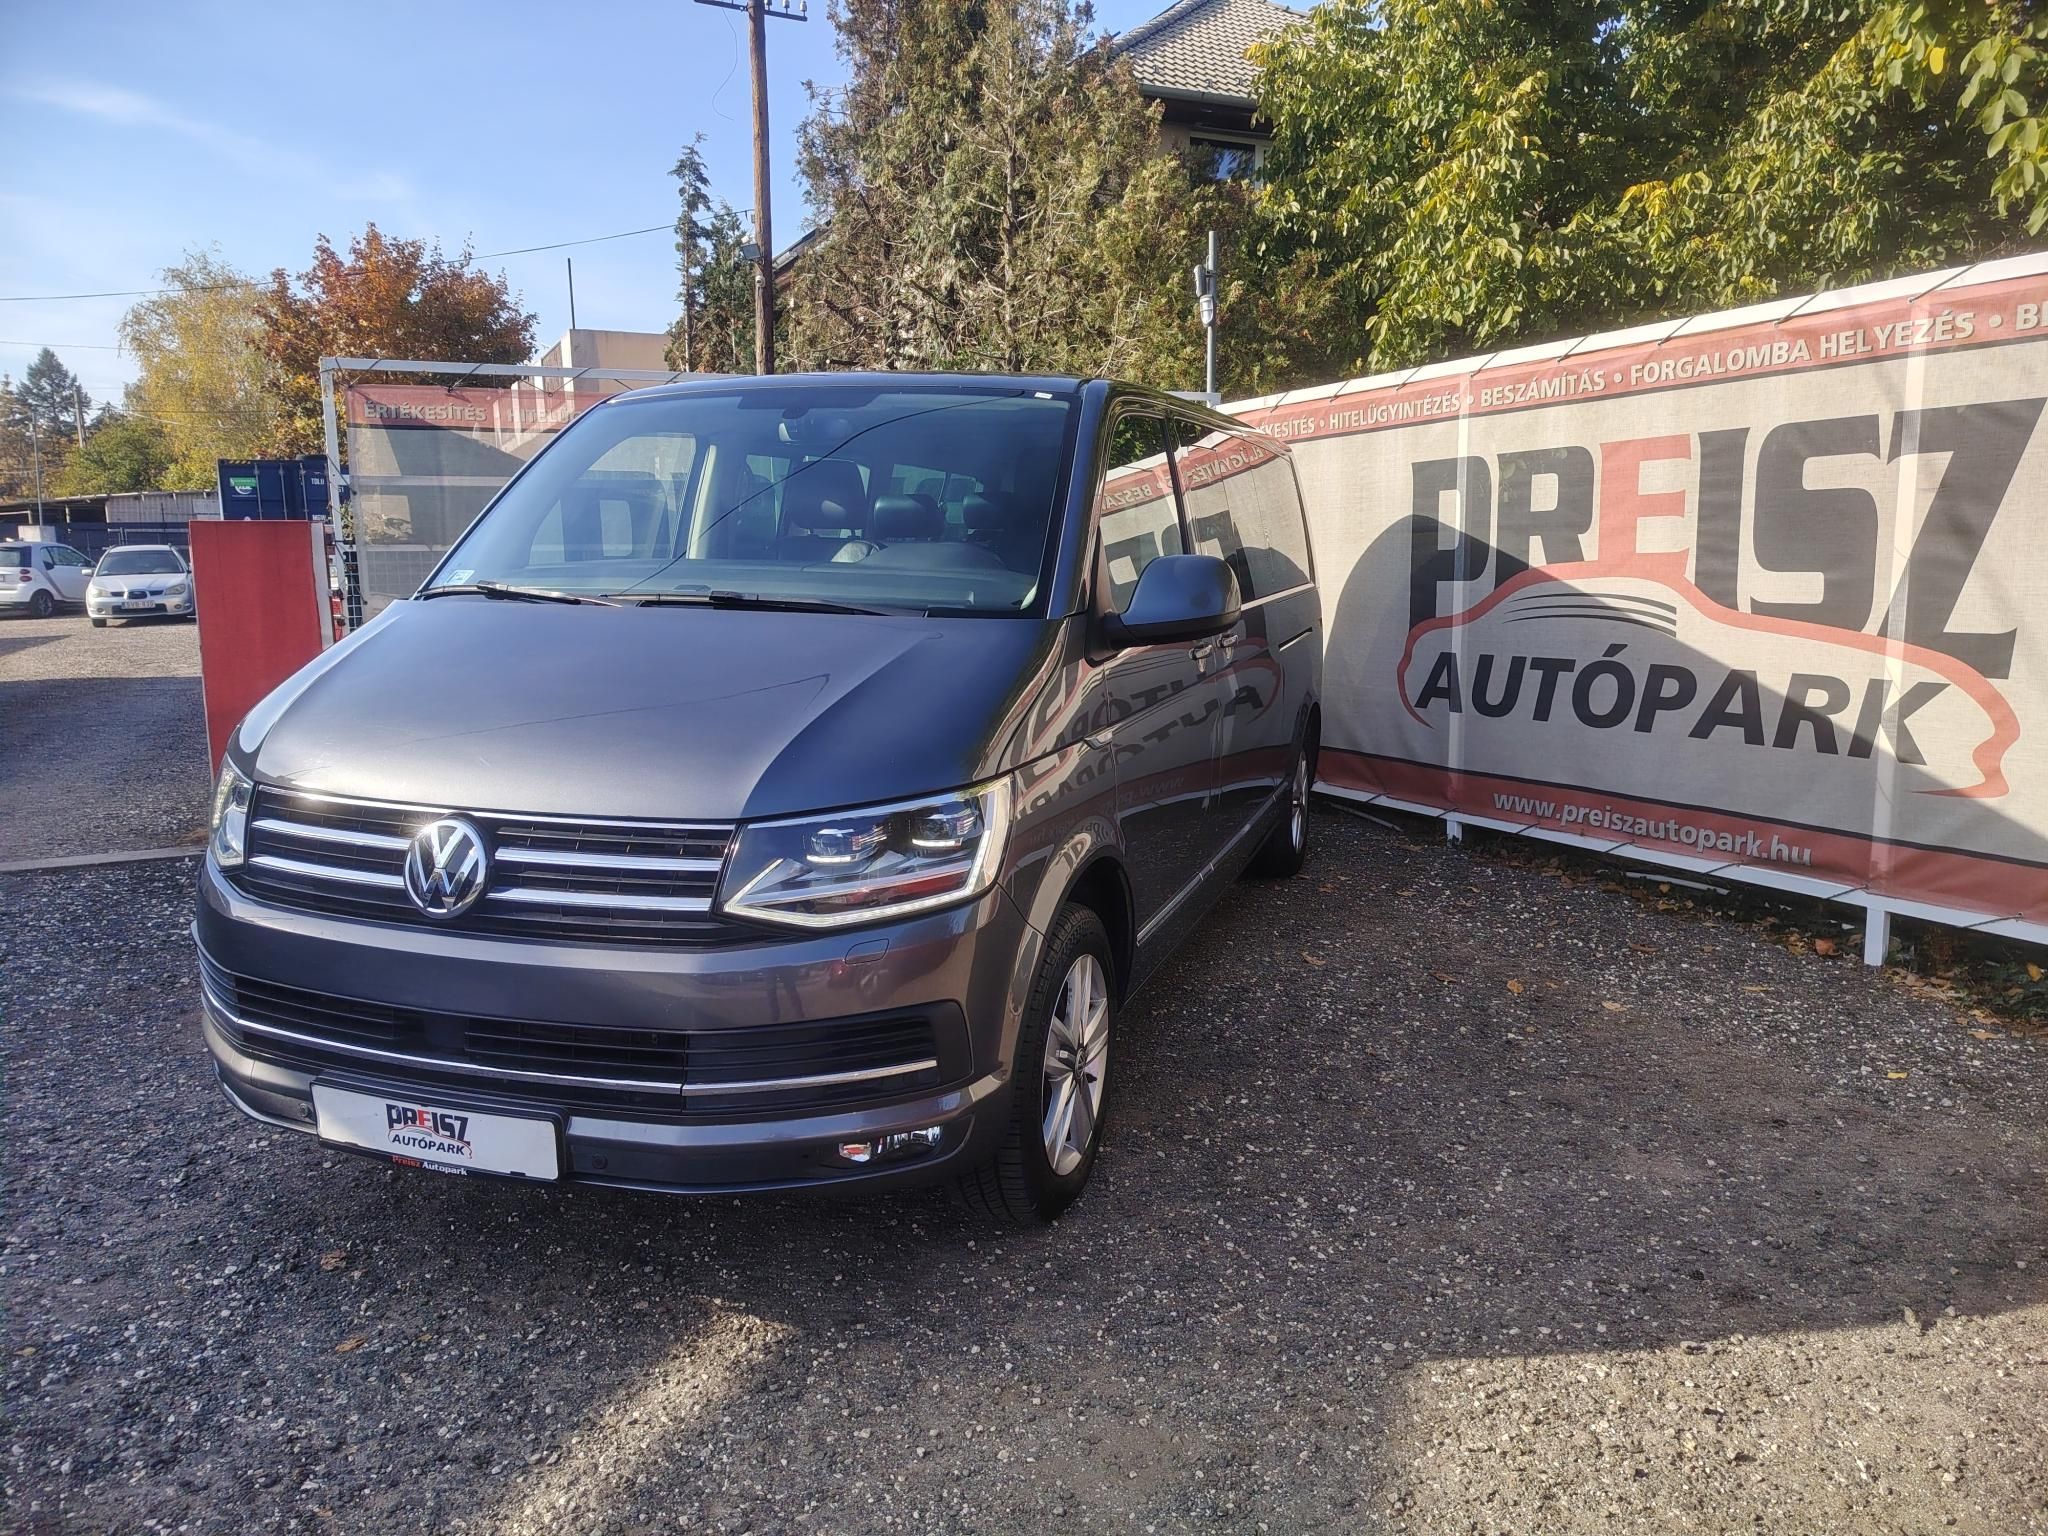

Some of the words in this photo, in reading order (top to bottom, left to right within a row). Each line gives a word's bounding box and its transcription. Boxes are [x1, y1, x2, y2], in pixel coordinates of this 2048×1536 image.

[1329, 393, 1461, 430] HITELÜGYINTÉZÉS
[1480, 369, 1606, 408] BESZÁMÍTÁS
[1630, 338, 1811, 386] FORGALOMBA
[1819, 309, 1976, 359] HELYEZÉS
[363, 402, 487, 422] ÉRTÉKESÍTÉS
[1409, 397, 2048, 679] PREISZ
[1414, 643, 1951, 766] AUTÓPARK
[1493, 792, 1813, 867] www.preiszautopark.hu
[385, 1103, 471, 1146] PREISZ
[391, 1132, 465, 1156] AUTÓPARK
[392, 1155, 421, 1169] Preisz
[422, 1160, 468, 1176] Autopark
